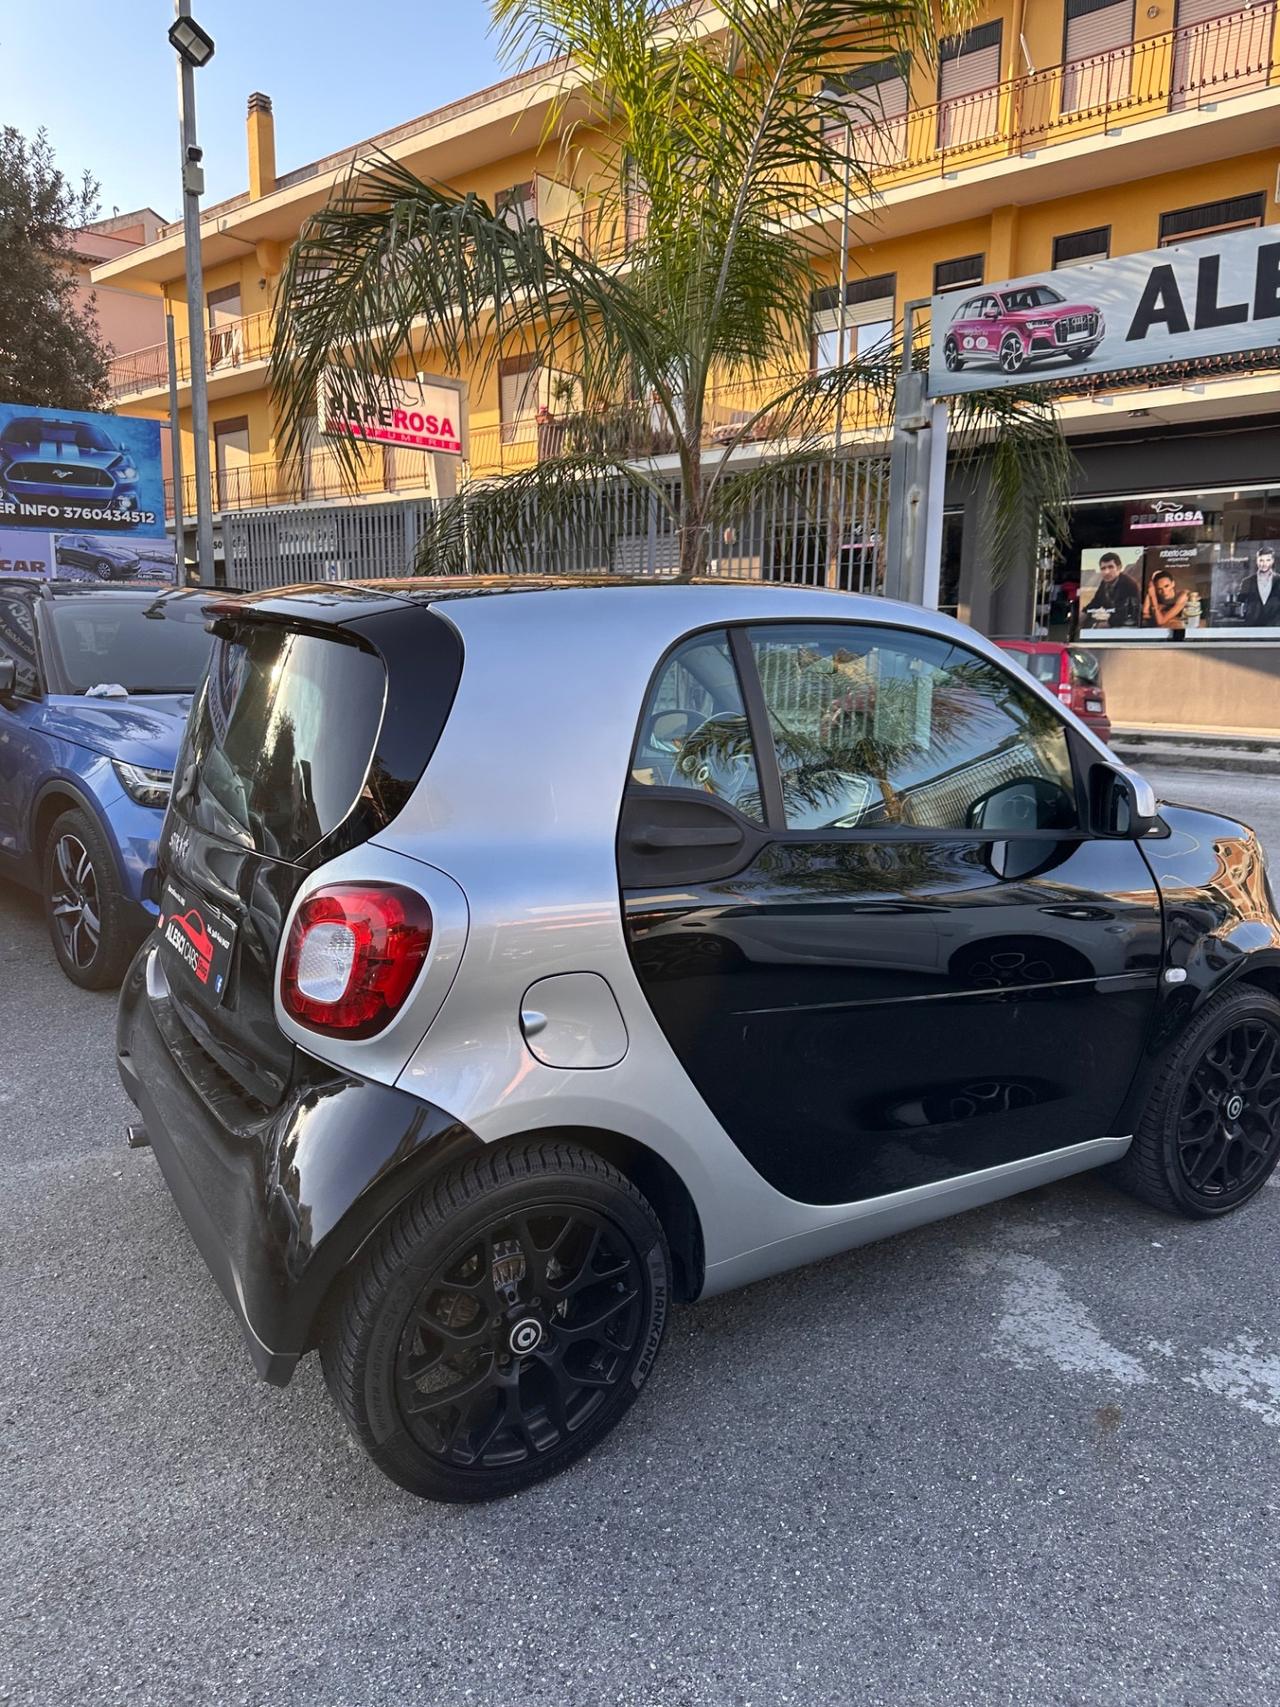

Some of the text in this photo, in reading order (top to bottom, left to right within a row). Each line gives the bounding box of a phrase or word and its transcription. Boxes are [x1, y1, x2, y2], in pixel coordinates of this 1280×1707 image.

[20, 504, 60, 518] INFO
[63, 506, 155, 524] 3760434512
[1130, 510, 1203, 524] PEPEROSA
[165, 922, 187, 956] ALESCI
[184, 942, 199, 972] CARS
